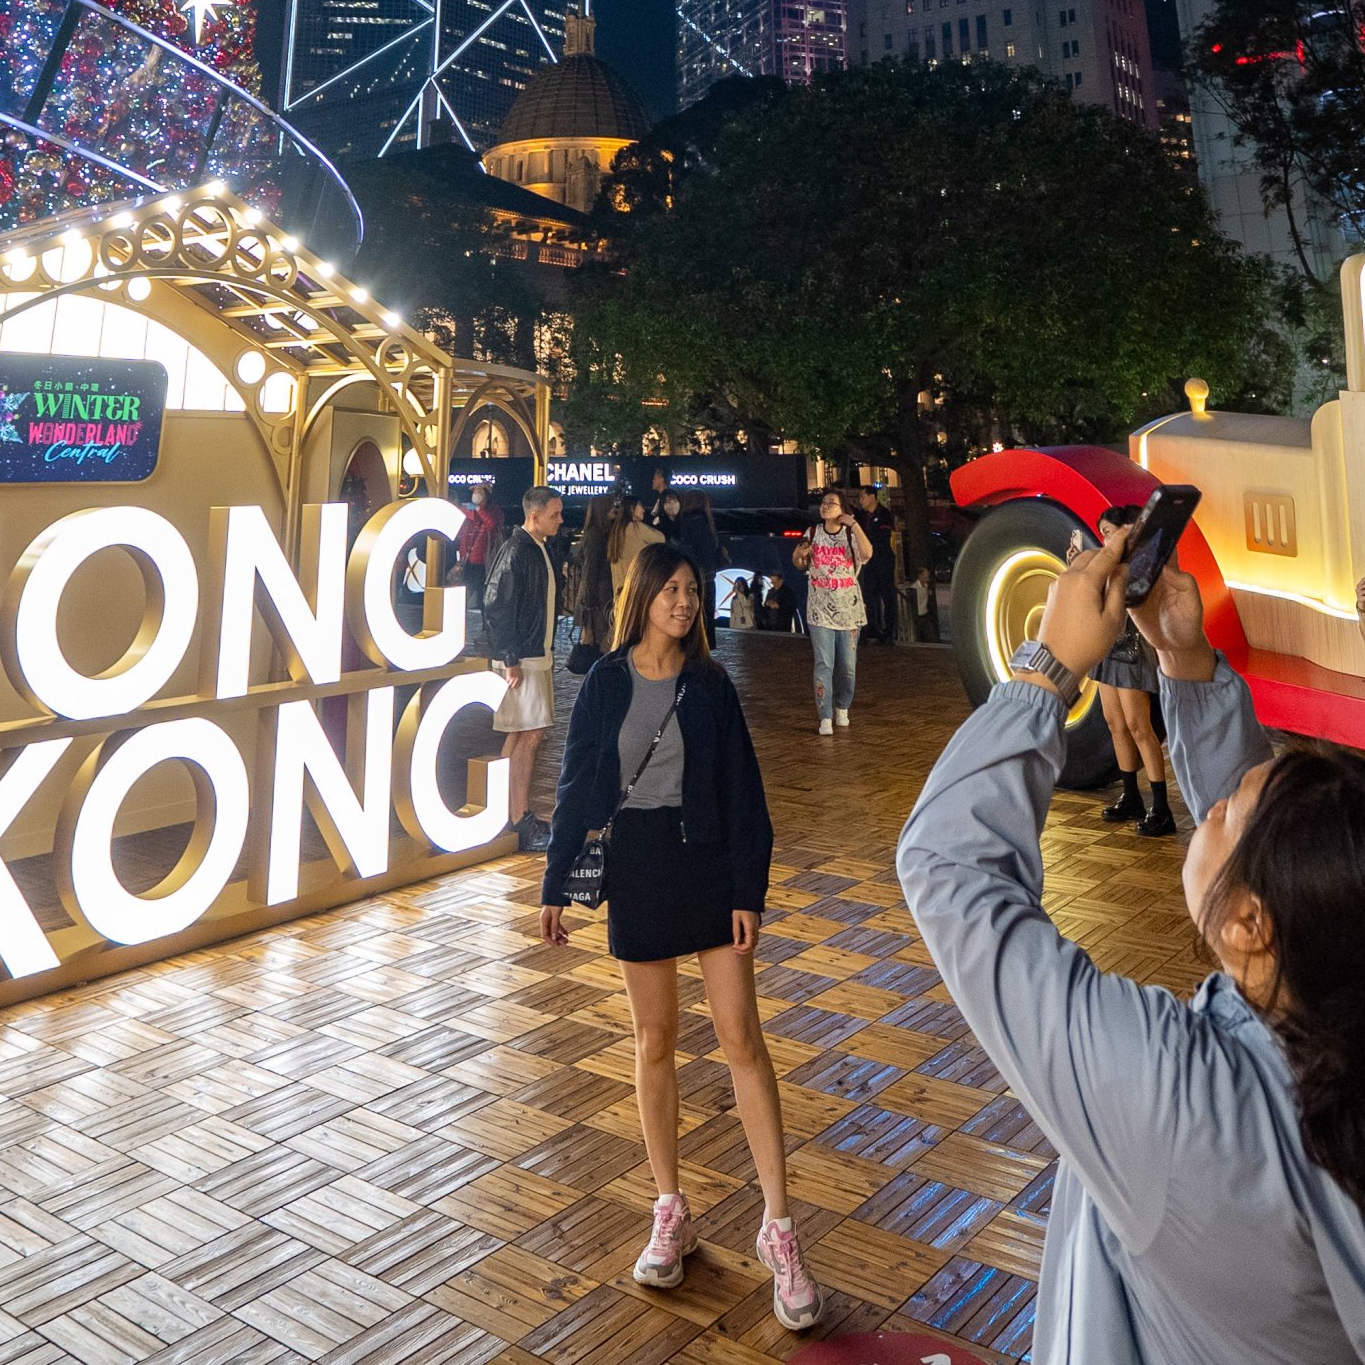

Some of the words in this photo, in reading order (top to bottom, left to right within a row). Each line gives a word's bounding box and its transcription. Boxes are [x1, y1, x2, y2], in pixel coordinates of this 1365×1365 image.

[33, 392, 141, 421] WINTER
[28, 421, 140, 446] WONDERLAND
[43, 440, 122, 465] Central
[448, 474, 467, 485] OCO
[546, 462, 616, 482] CHANEL
[699, 474, 736, 485] CRUSH
[567, 485, 609, 496] JEWELLERY
